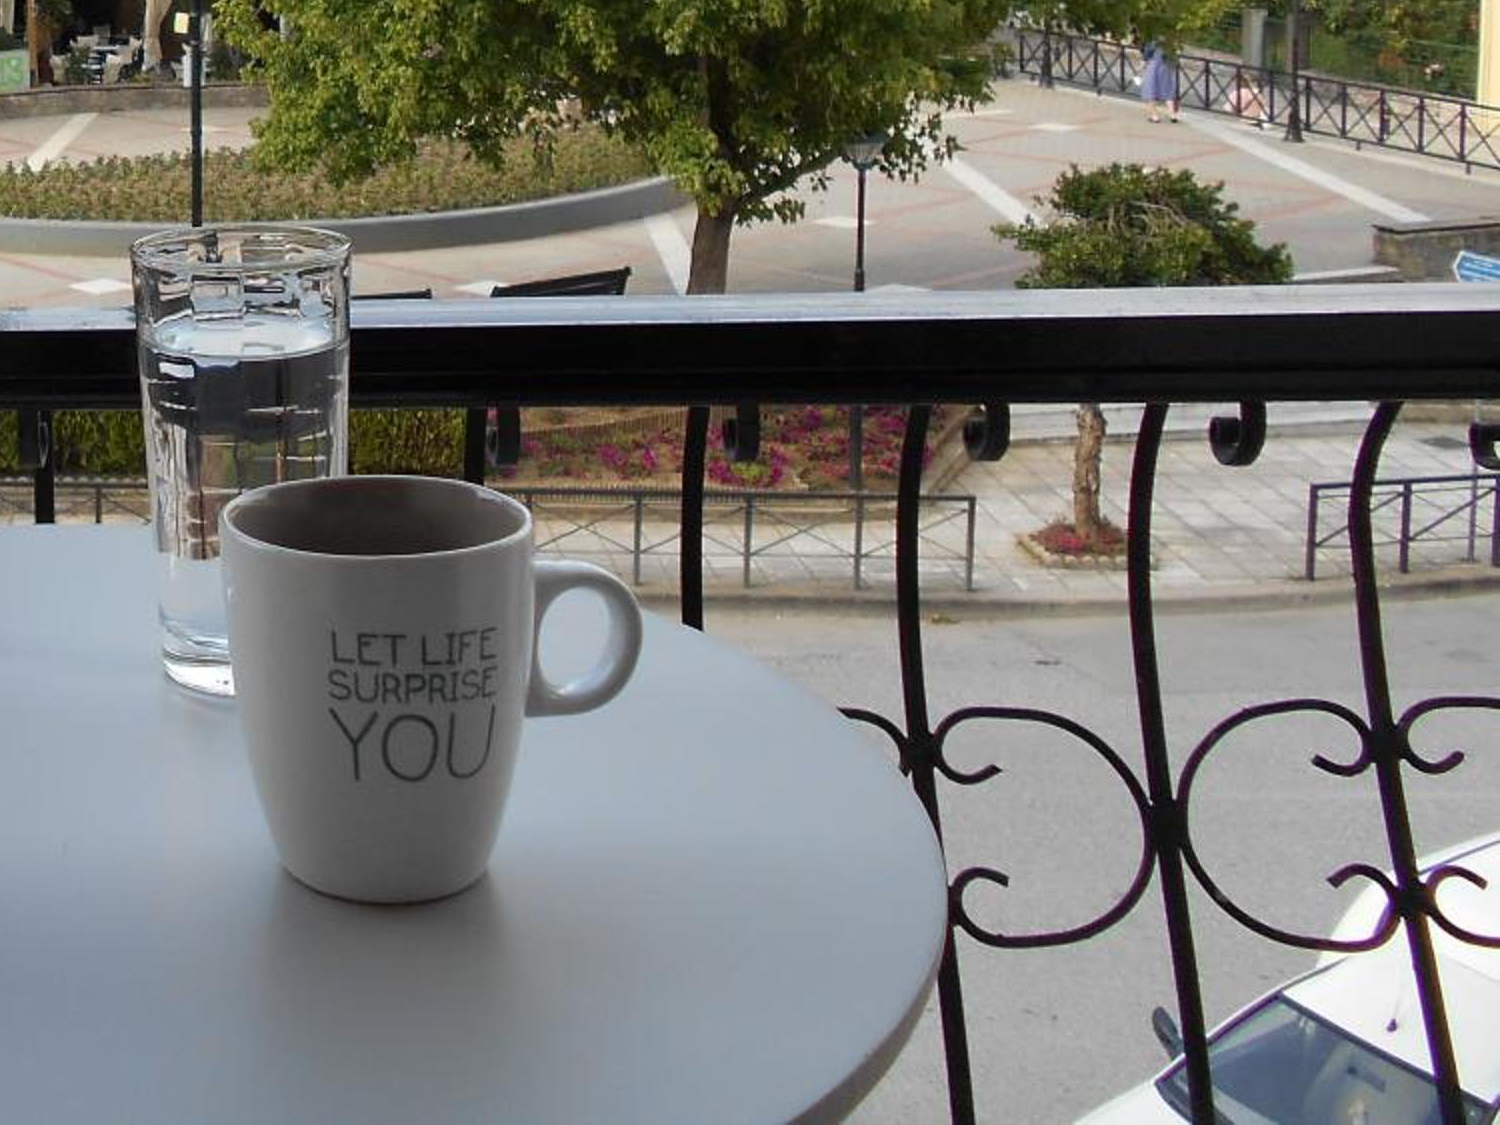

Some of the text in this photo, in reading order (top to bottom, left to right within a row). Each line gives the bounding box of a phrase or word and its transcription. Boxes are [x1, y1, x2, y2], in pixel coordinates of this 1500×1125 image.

[331, 627, 498, 667] LET LIFE
[327, 666, 498, 704] SURPRISE
[328, 705, 496, 782] YOU
